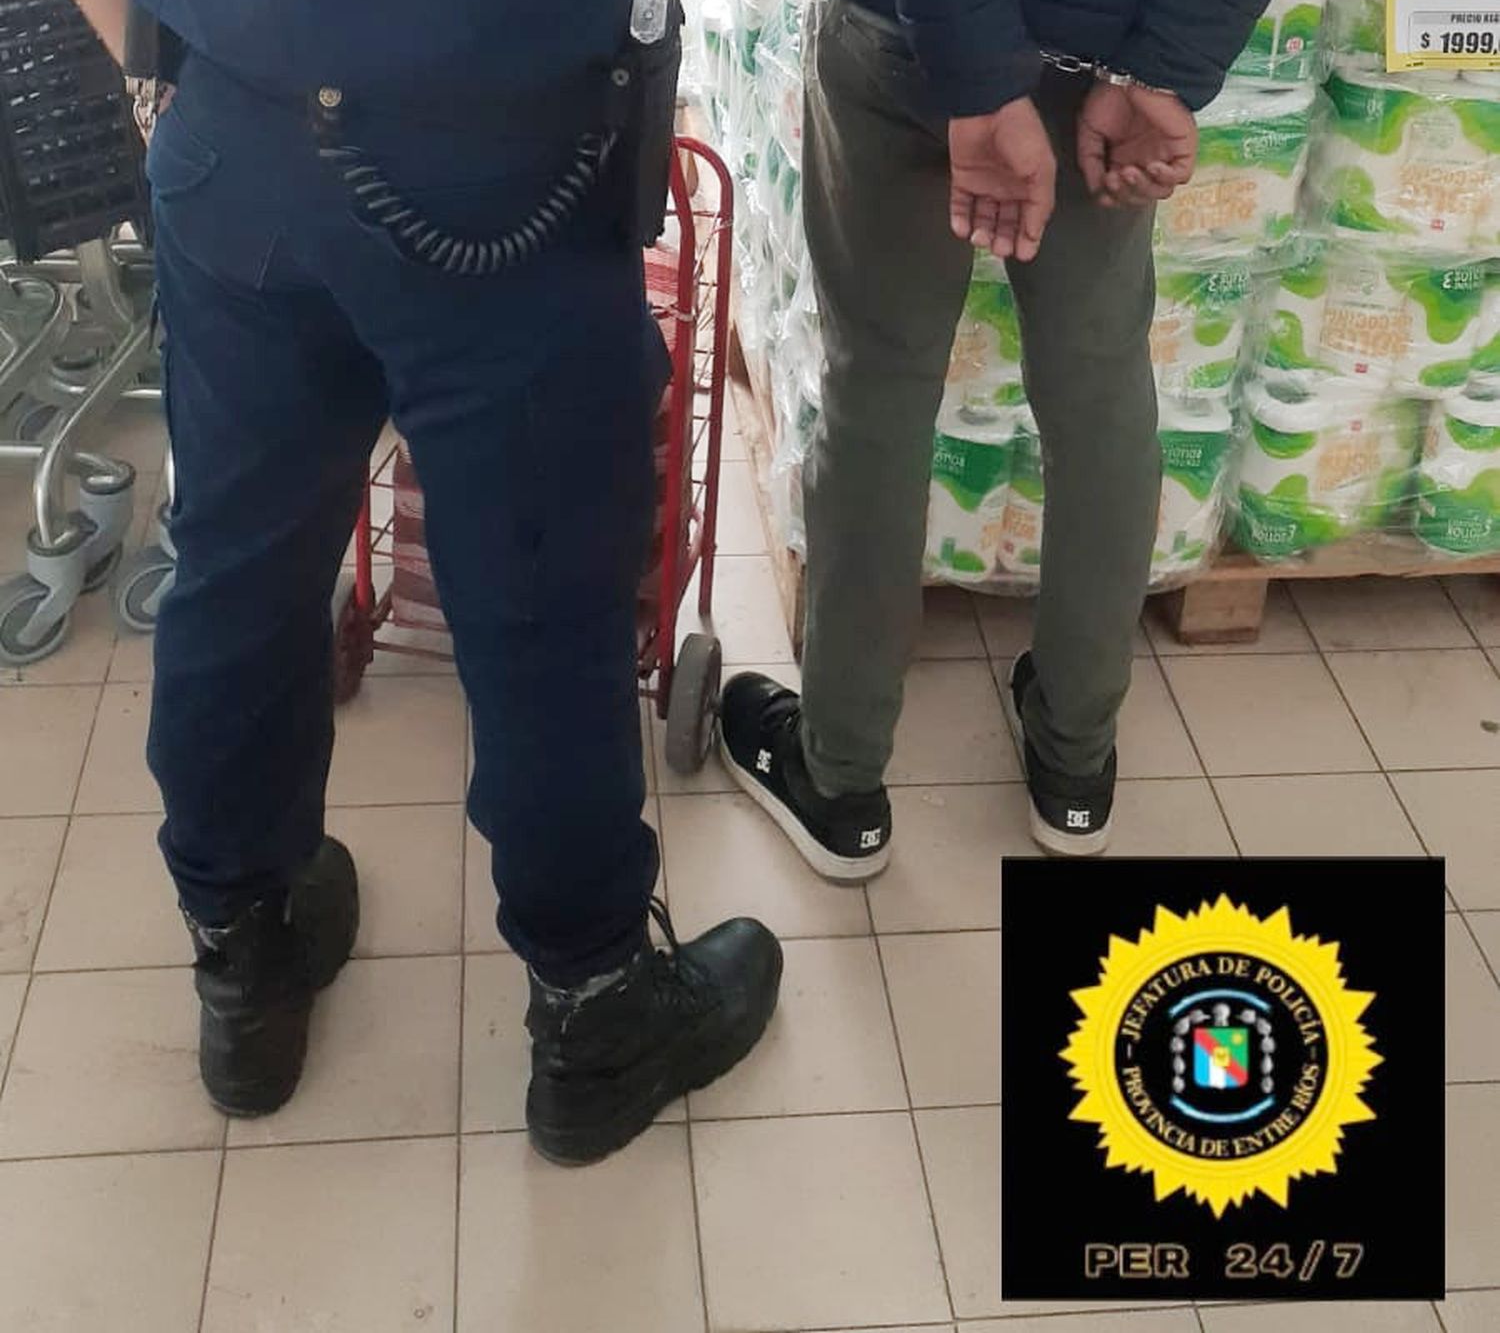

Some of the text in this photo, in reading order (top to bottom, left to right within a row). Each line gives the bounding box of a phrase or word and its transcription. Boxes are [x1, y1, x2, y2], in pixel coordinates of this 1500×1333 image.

[1451, 14, 1482, 24] PRECIO
[1421, 32, 1430, 48] $
[1443, 271, 1454, 289] 3
[1067, 809, 1090, 828] DC
[860, 827, 882, 849] DC
